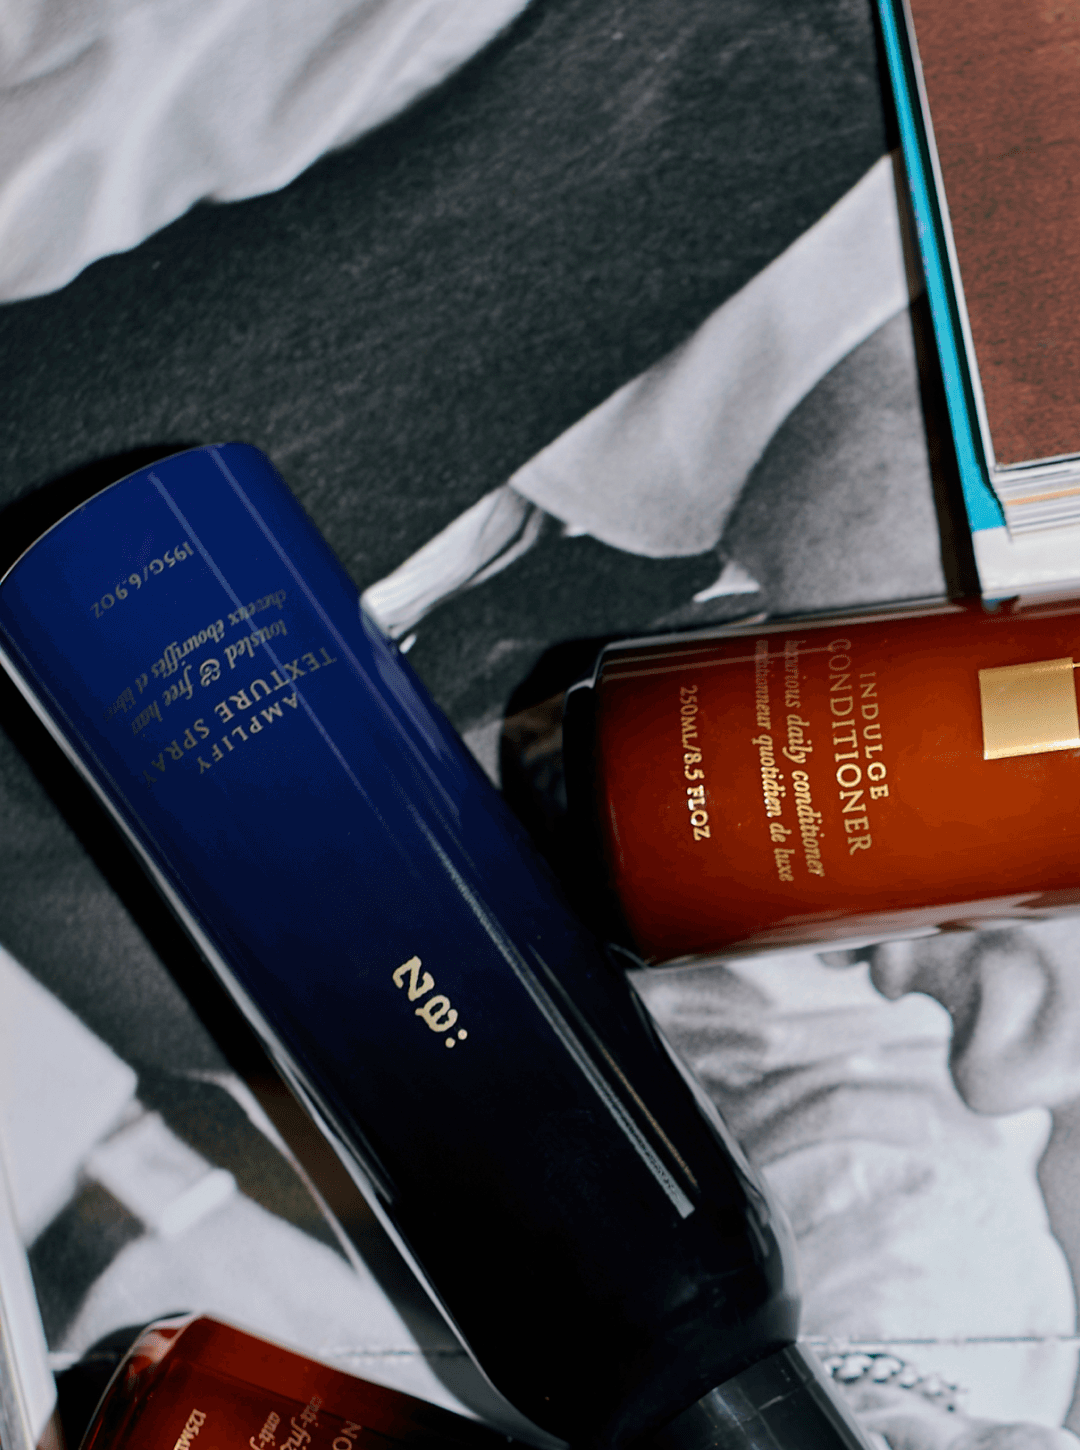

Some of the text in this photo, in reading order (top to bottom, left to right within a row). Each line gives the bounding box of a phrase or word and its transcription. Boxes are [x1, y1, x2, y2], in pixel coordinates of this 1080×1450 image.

[130, 619, 288, 738] tousled & free hair
[134, 672, 149, 695] et
[151, 619, 226, 679] ébouriffés
[147, 647, 337, 788] TEXTURE SPRAY
[197, 688, 304, 774] AMPLIFY
[679, 685, 706, 781] 250ML/8.5
[781, 713, 814, 765] daily
[823, 638, 873, 855] CONDITIONER
[860, 672, 890, 801] INDULGE
[751, 734, 786, 818] quotidien
[768, 821, 793, 843] de
[772, 847, 796, 882] luxe
[791, 769, 826, 877] conditioner
